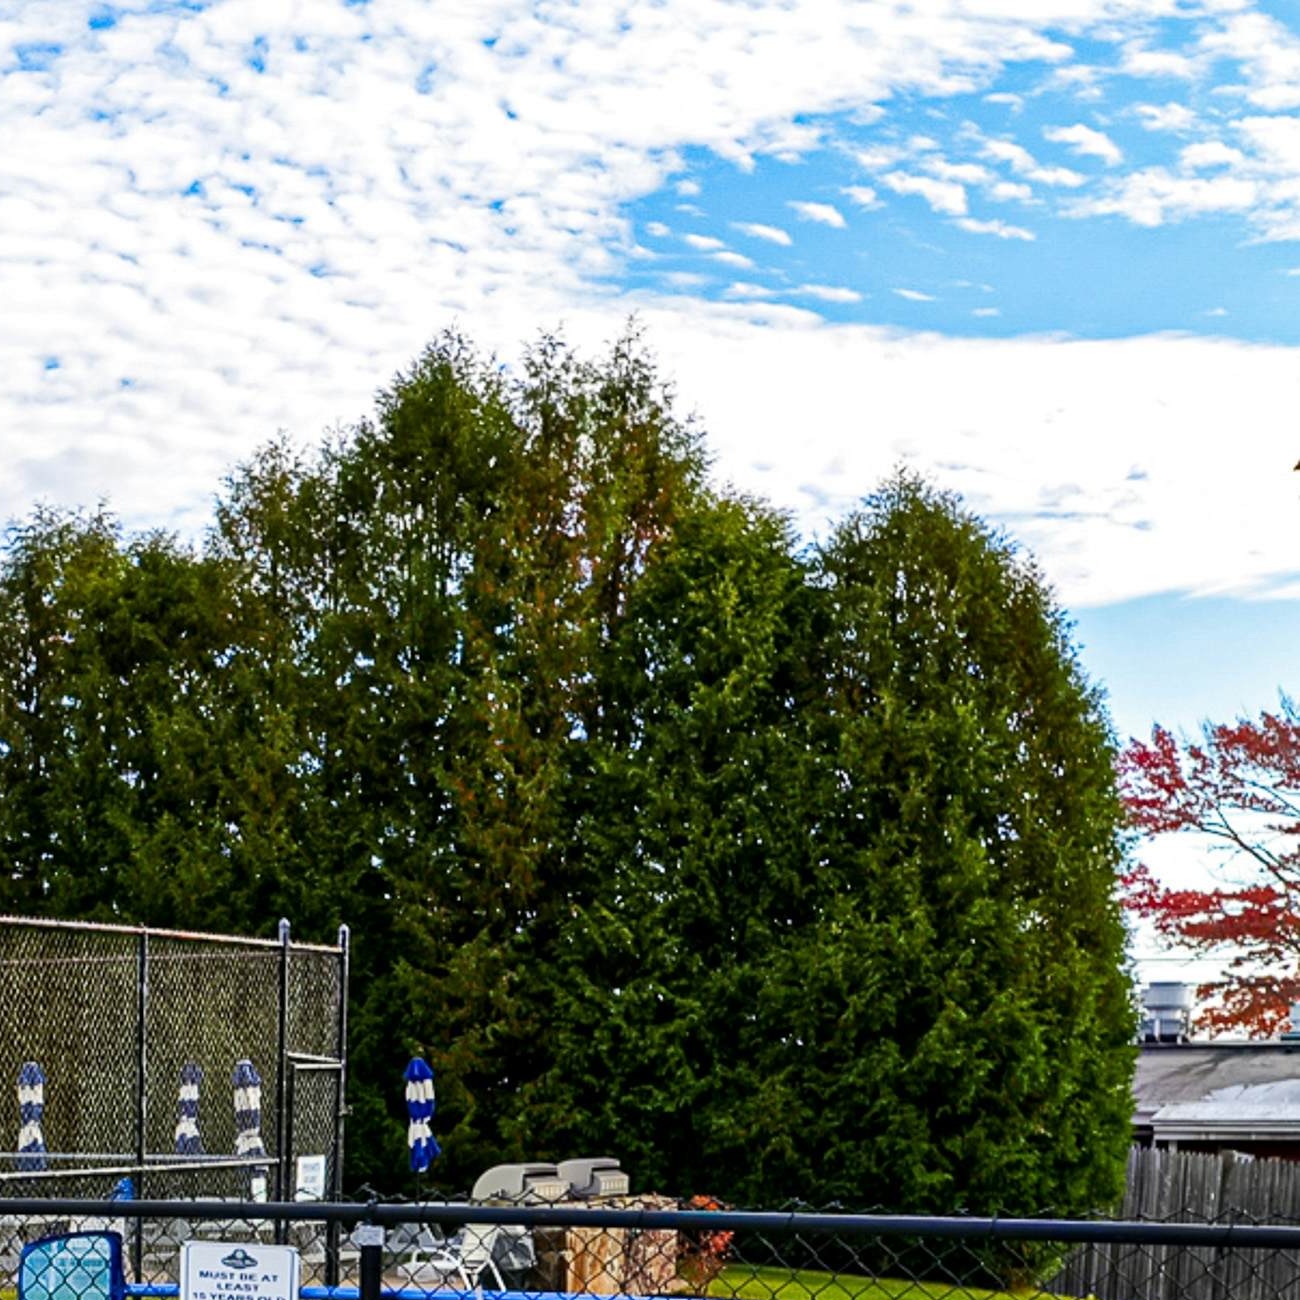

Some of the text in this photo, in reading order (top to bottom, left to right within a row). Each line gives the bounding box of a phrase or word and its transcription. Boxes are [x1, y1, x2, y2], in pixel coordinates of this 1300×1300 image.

[199, 1270, 278, 1282] MUST BE AT
[216, 1283, 259, 1292] LEAST
